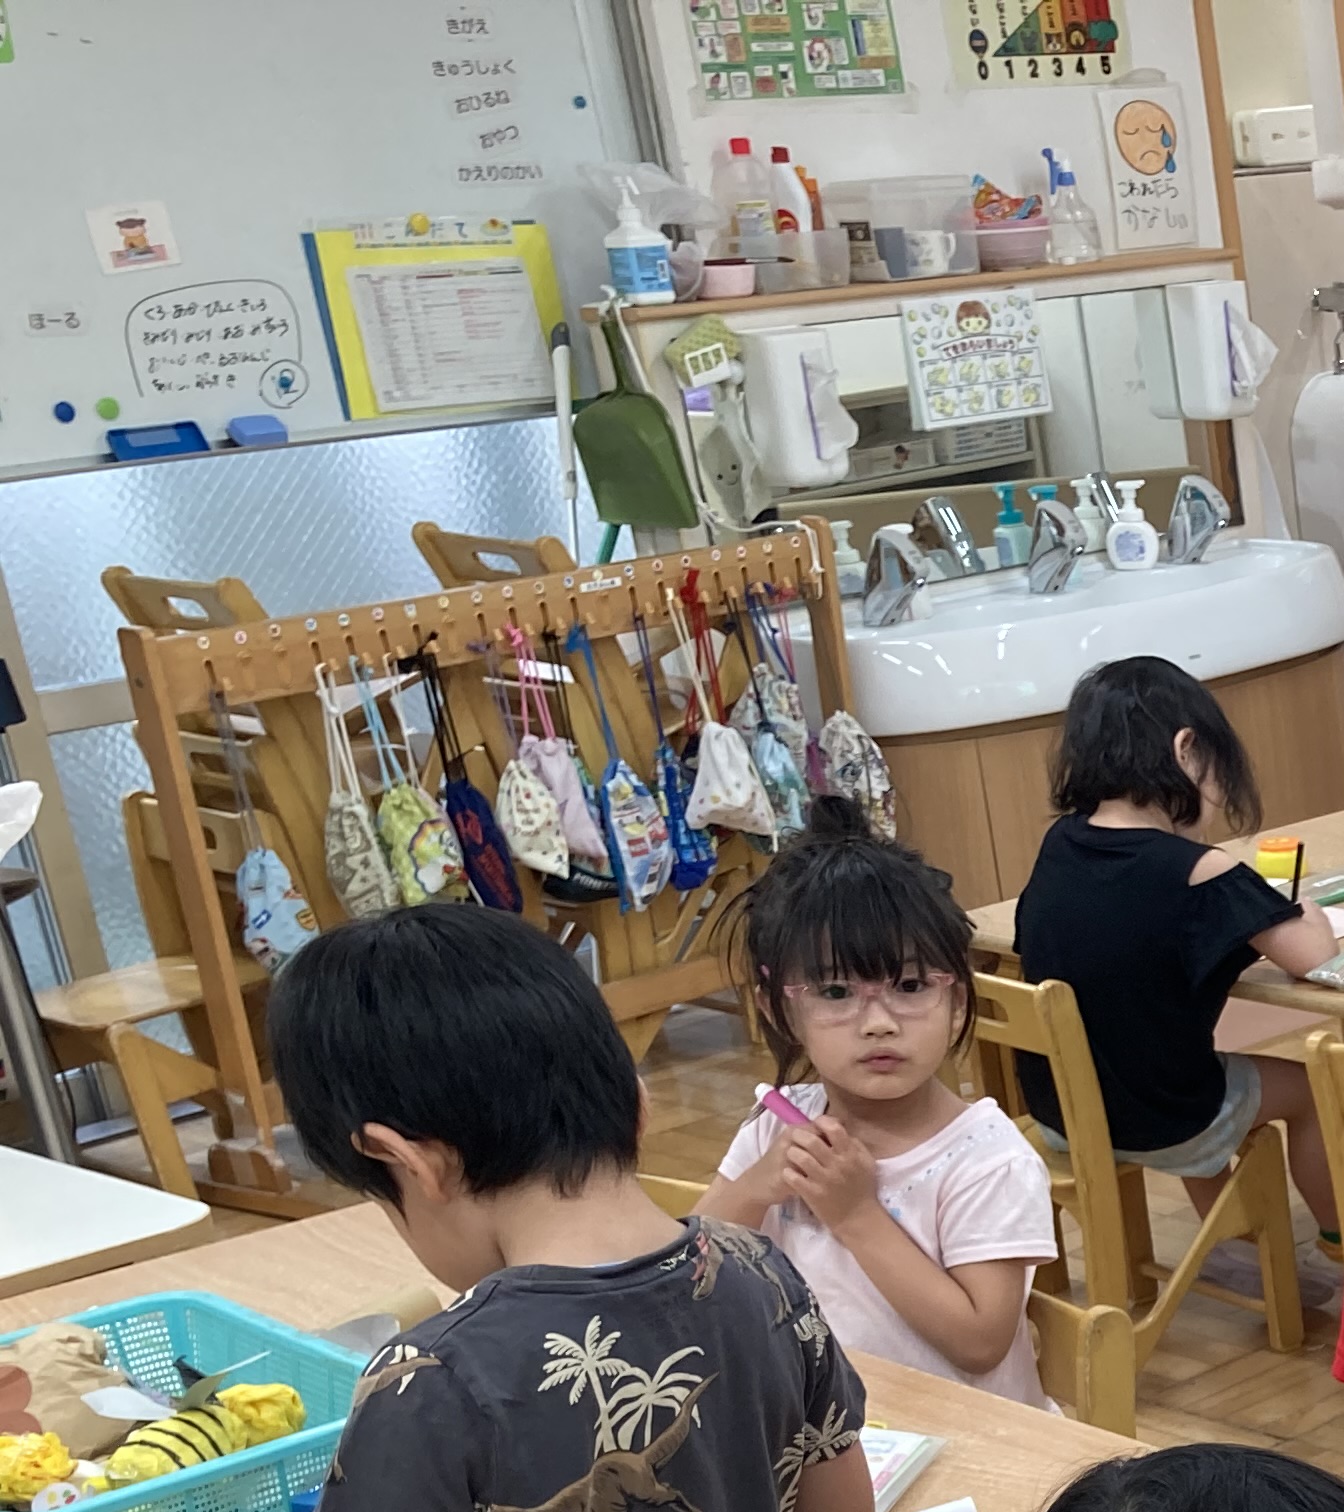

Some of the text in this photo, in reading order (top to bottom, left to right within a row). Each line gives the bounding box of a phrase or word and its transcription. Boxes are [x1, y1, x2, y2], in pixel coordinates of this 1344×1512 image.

[446, 18, 490, 35] きがえ
[432, 59, 516, 77] きゅうしょく
[977, 55, 1112, 80] 0 1 2 3 4 5
[455, 89, 511, 114] おひるね
[479, 125, 519, 149] おやつ
[457, 164, 544, 182] かえりのかい
[1121, 204, 1189, 232] かなしい
[383, 221, 468, 239] こだて
[28, 311, 81, 330] ほーる
